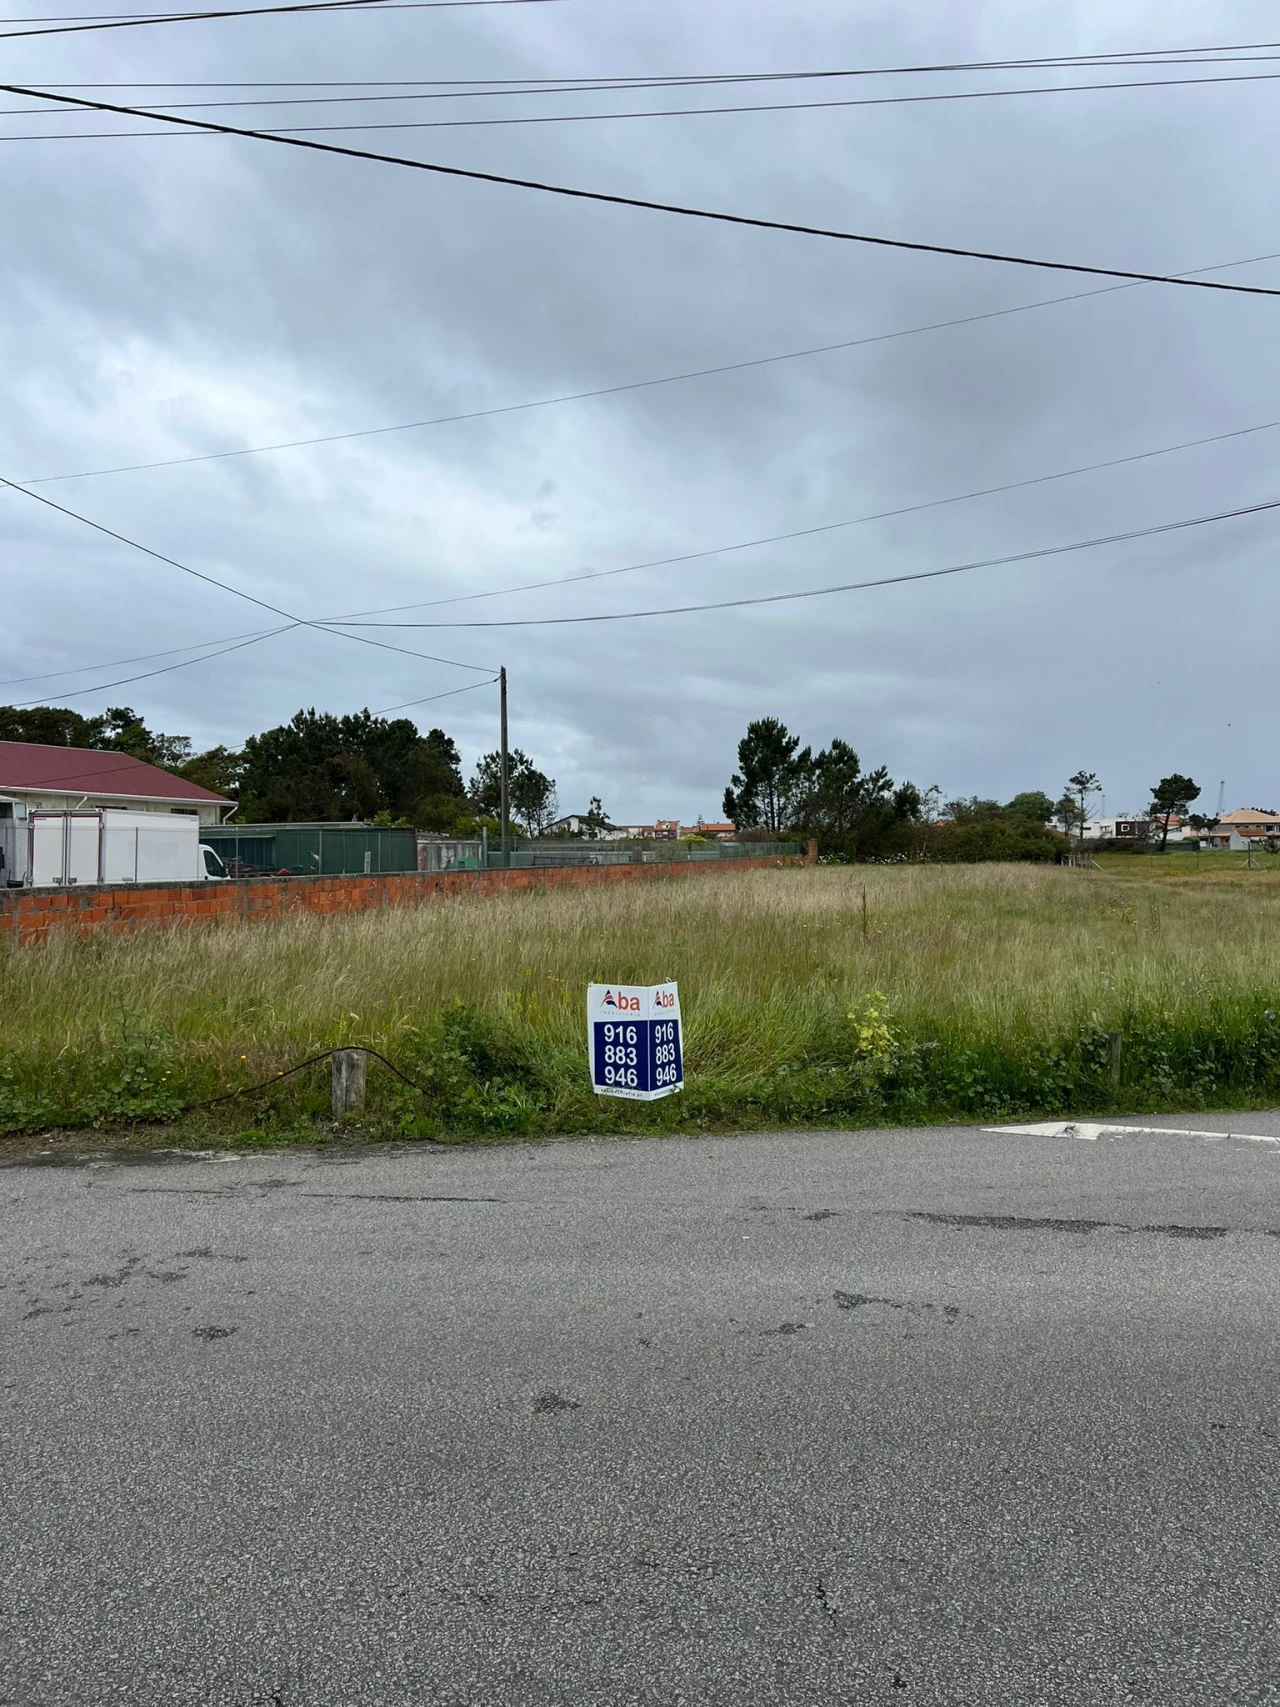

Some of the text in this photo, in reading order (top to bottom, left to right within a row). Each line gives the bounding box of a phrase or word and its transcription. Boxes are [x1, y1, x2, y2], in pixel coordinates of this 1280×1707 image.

[604, 1024, 637, 1044] 916
[655, 1022, 674, 1043] 916
[604, 1045, 637, 1065] 883
[655, 1043, 675, 1064] 883
[604, 1066, 638, 1086] 946
[656, 1063, 677, 1086] 946
